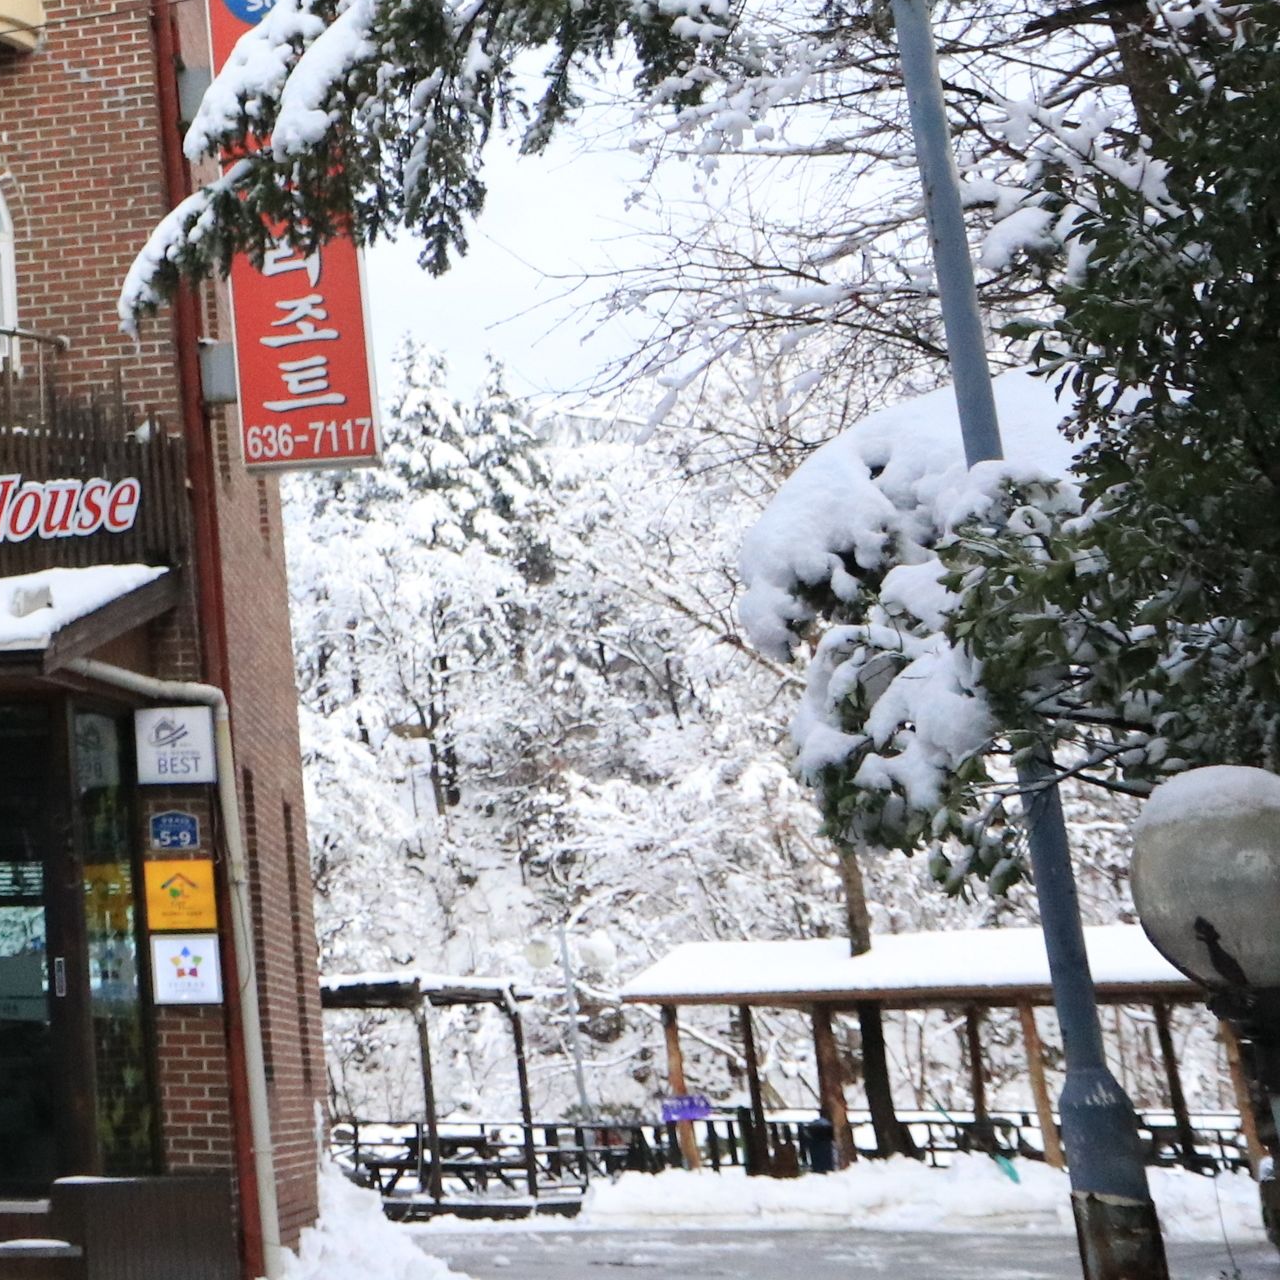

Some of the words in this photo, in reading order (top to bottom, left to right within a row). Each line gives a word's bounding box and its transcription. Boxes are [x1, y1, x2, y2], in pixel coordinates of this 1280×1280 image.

[247, 416, 372, 460] 636-7117
[157, 756, 201, 776] BEST
[159, 830, 192, 847] 5-9
